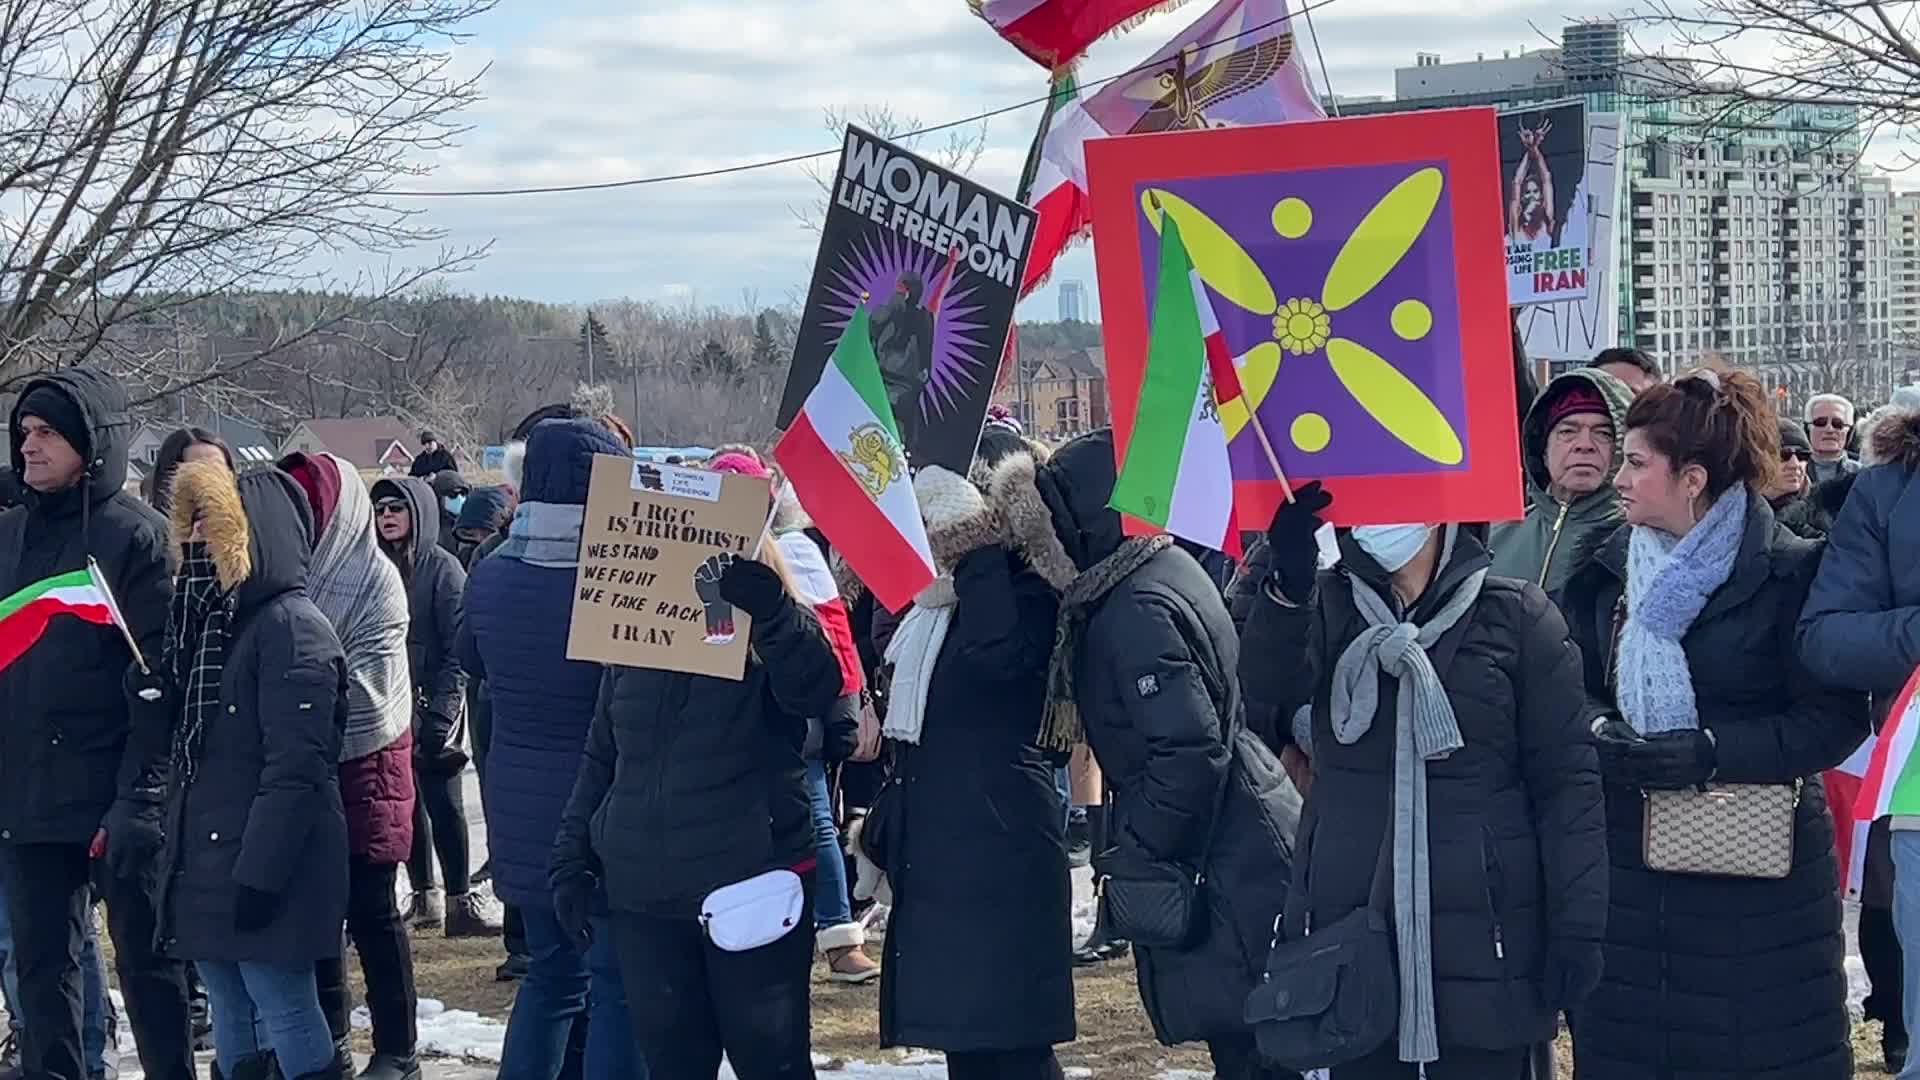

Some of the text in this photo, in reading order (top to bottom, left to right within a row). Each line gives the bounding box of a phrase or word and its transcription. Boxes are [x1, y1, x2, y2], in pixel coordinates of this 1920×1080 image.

[844, 132, 1030, 260] WOMAN
[1533, 247, 1581, 273] FREE
[1533, 268, 1585, 293] IRAN
[579, 587, 606, 603] WE
[611, 593, 648, 611] TAKE
[611, 623, 676, 647] IRAN
